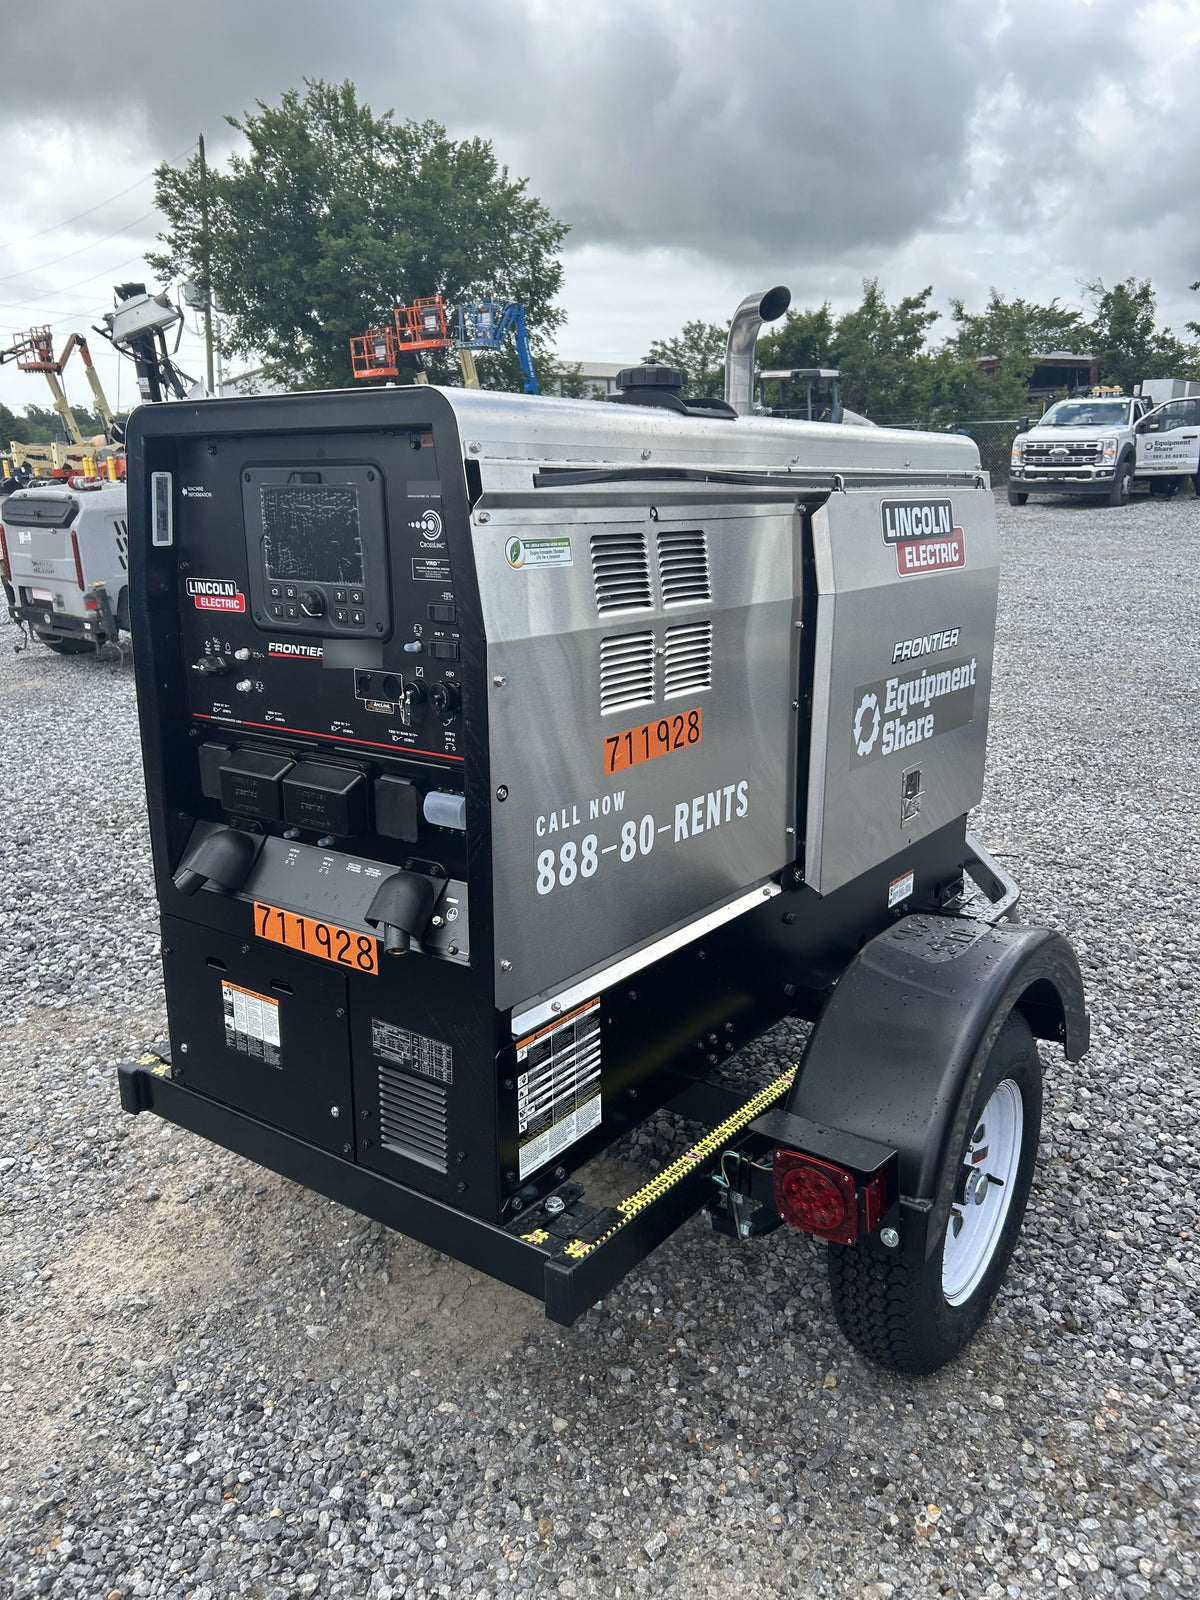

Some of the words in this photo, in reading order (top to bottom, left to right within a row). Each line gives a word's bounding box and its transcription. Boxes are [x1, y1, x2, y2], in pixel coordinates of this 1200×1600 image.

[885, 505, 951, 538] LINCOLN
[904, 541, 960, 568] ELECTRIC
[188, 581, 234, 596] LINCOLN
[200, 597, 240, 609] ELECTRIC
[892, 627, 961, 664] FRONTIER
[884, 658, 977, 716] Equipment
[606, 710, 700, 772] 711928
[882, 714, 934, 756] Share
[536, 805, 580, 837] CALL
[589, 790, 625, 820] NOW
[536, 780, 749, 895] 888-80-RENTS
[257, 904, 374, 971] 711928
[710, 1130, 726, 1144] PAS
[724, 1112, 750, 1131] TENEZ
[748, 1090, 774, 1112] DEBOUT
[637, 1178, 668, 1202] STAND
[666, 1160, 692, 1179] HERE
